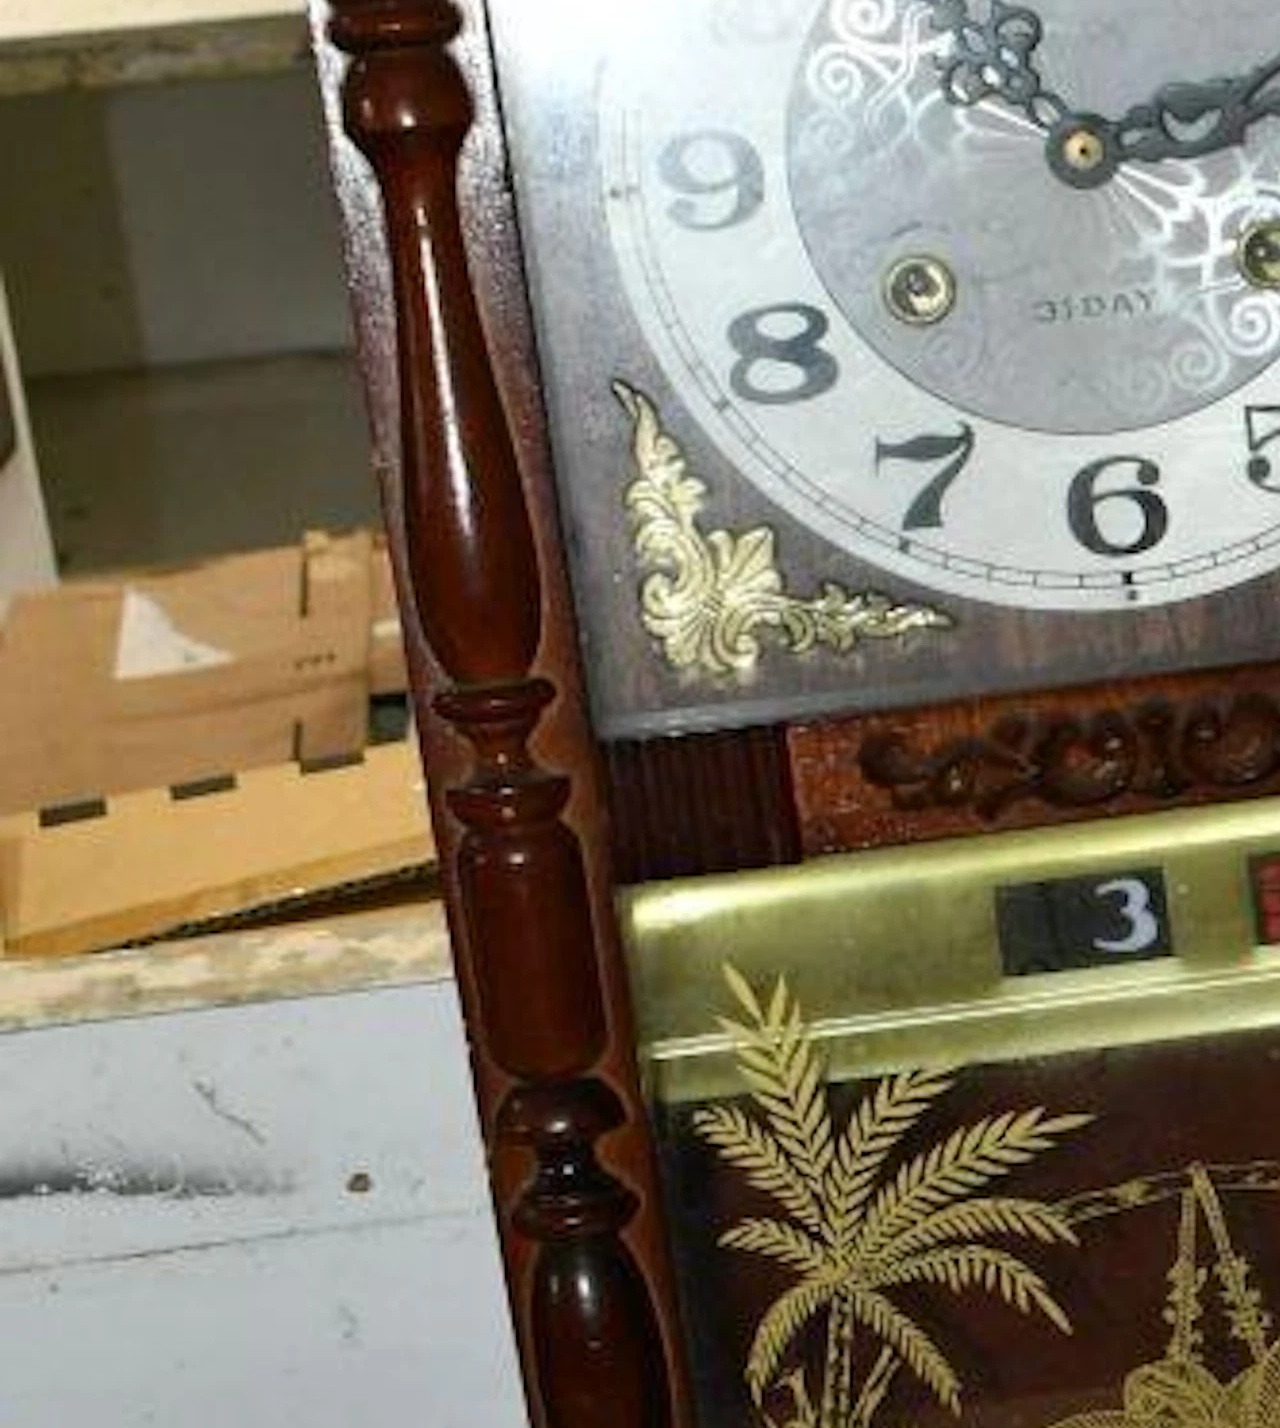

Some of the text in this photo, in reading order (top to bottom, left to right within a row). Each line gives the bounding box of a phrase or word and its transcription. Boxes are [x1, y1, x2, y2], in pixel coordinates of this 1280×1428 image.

[656, 130, 763, 232] 9
[726, 302, 839, 406] 8
[875, 421, 976, 534] 7
[1066, 455, 1169, 558] 6
[1094, 878, 1159, 953] 3
